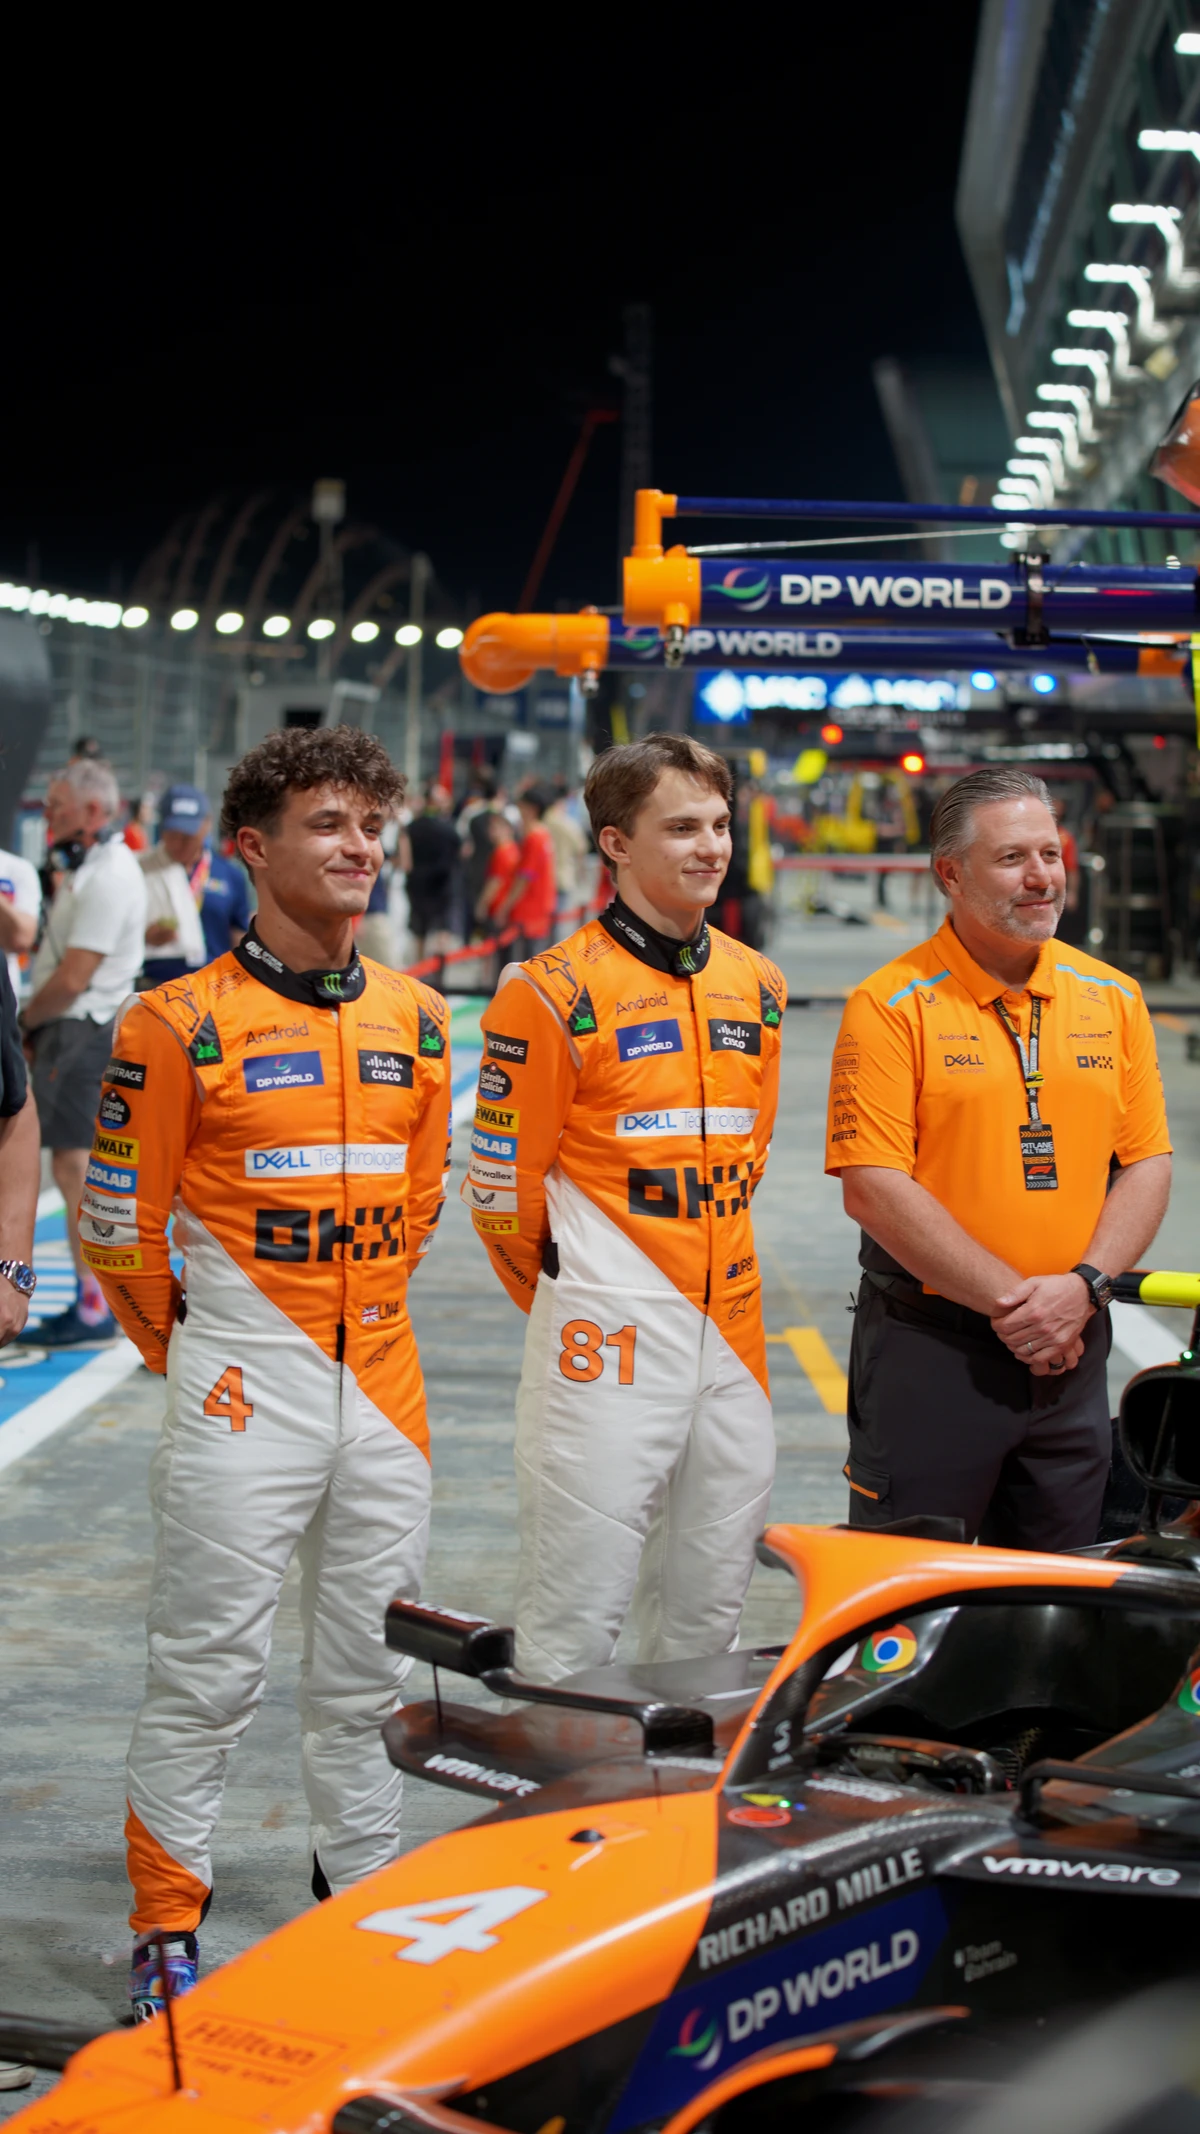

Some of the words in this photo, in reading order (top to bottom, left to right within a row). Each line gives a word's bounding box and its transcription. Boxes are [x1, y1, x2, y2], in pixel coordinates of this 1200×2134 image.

[780, 574, 842, 606] DP
[846, 576, 1012, 610] WORLD
[717, 631, 843, 658] WORLD
[616, 990, 668, 1016] Android
[246, 1020, 309, 1047] Android
[722, 1036, 746, 1050] CISCO
[938, 1033, 968, 1041] Android
[1066, 1030, 1112, 1039] McLaren
[627, 1046, 641, 1057] DP
[641, 1041, 673, 1053] WORLD
[944, 1054, 985, 1068] DELL
[1076, 1055, 1114, 1070] OKX
[256, 1077, 273, 1088] DP
[273, 1073, 315, 1086] WORLD
[371, 1069, 402, 1082] CISCO
[624, 1113, 677, 1131] DELL
[833, 1112, 858, 1127] FxPro
[97, 1138, 134, 1157] WALT
[253, 1150, 311, 1170] DELL
[314, 1148, 405, 1171] Technologies
[472, 1165, 512, 1180] Airwallex
[91, 1199, 131, 1216] Airwallex
[493, 1244, 528, 1285] RICHARD
[116, 1284, 155, 1331] RICHARD
[152, 1329, 169, 1350] MIL
[559, 1319, 637, 1385] 81
[203, 1366, 253, 1432] 4
[423, 1753, 543, 1798] vmware
[982, 1855, 1182, 1887] vmware
[697, 1886, 830, 1971] RICHARD
[835, 1847, 925, 1910] MILLE
[353, 1885, 548, 1965] 4
[726, 1986, 781, 2044] DP
[781, 1928, 919, 2017] WORLD
[184, 2020, 317, 2067] Hilton
